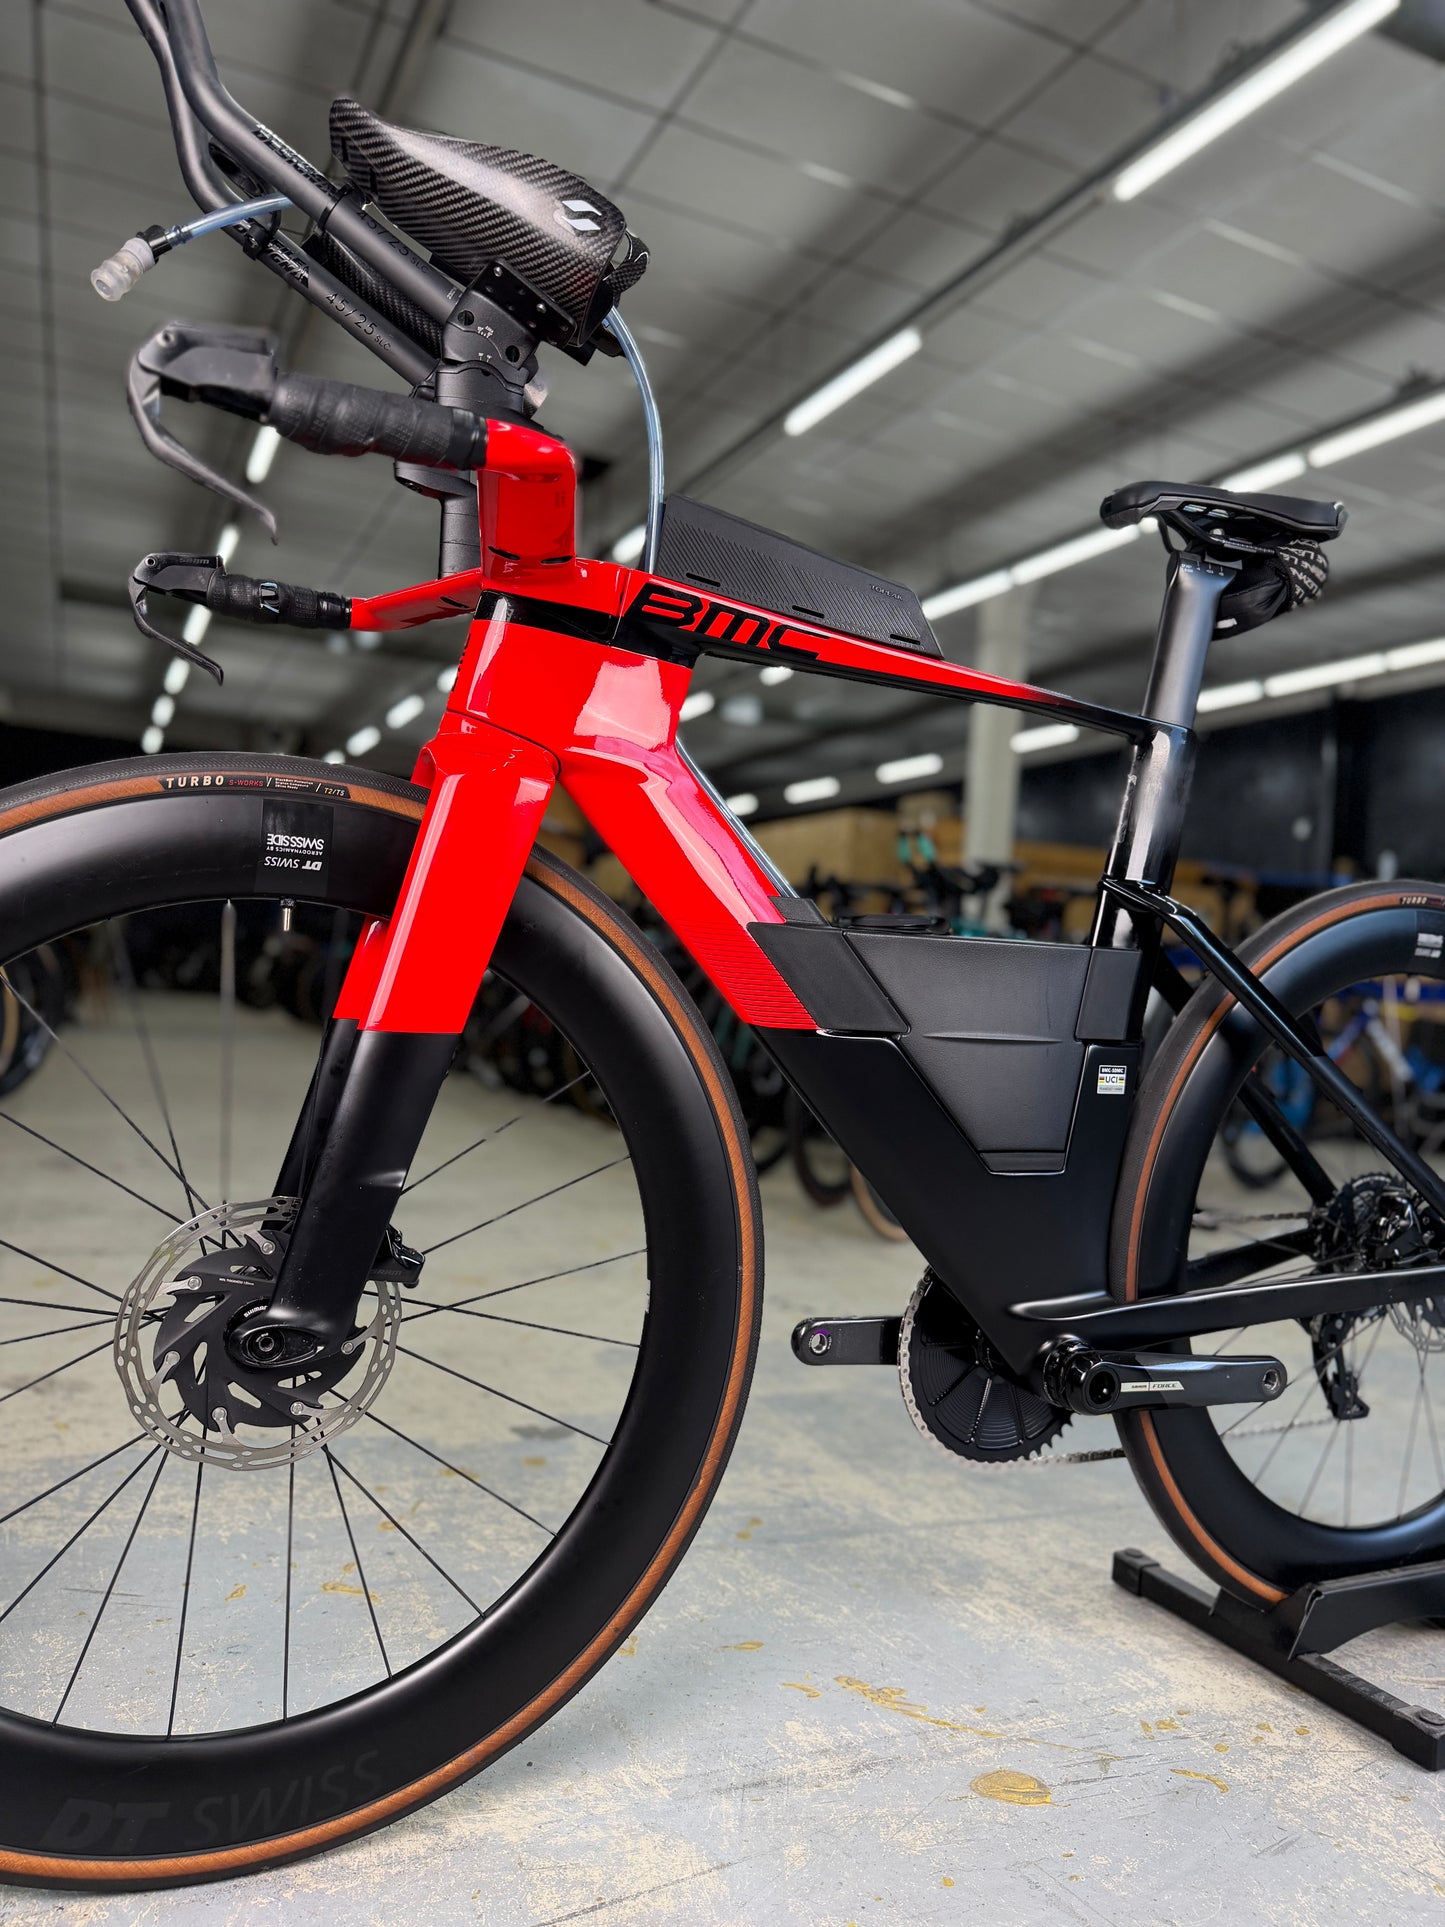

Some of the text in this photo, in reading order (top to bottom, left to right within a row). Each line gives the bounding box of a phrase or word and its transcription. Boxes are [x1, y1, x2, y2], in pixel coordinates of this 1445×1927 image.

[374, 335, 392, 351] SLC
[621, 582, 832, 660] BMC
[166, 775, 346, 797] TURBO S-WORKS T2/T5
[275, 846, 324, 856] AERODYNAMICS
[264, 856, 323, 871] DT SWISS
[38, 1747, 382, 1855] DT SWISS
